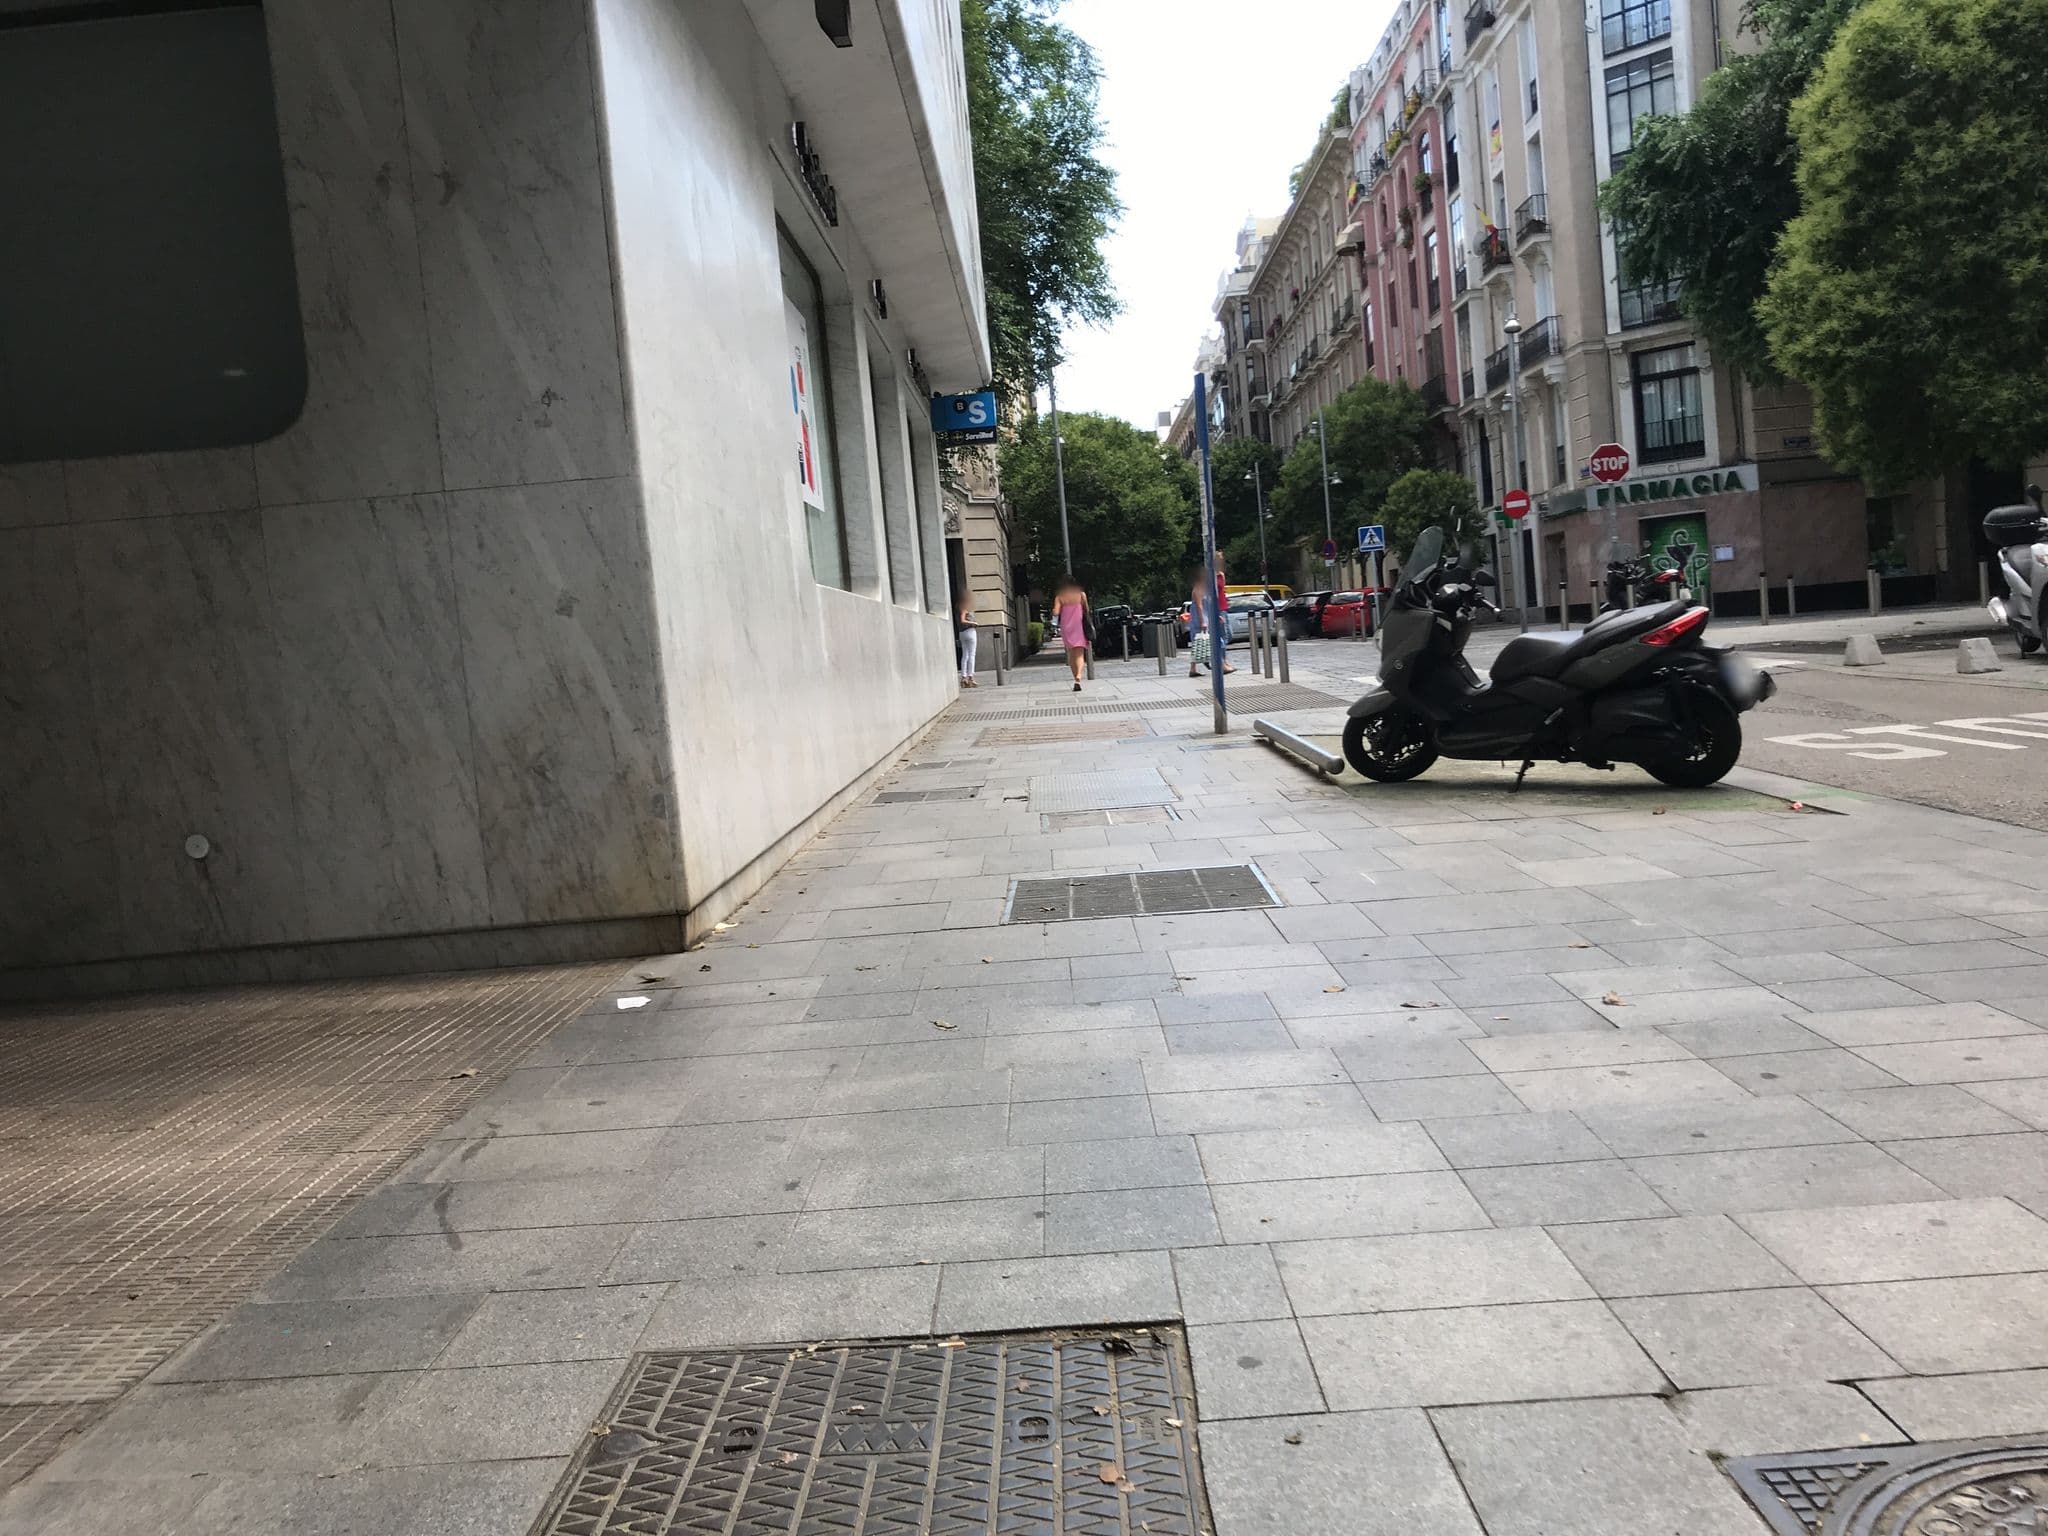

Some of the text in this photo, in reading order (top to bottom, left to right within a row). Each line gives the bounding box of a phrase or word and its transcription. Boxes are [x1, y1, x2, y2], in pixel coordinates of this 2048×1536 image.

[968, 400, 987, 424] S
[1592, 456, 1628, 472] STOP
[1597, 470, 1745, 507] FARMACIA
